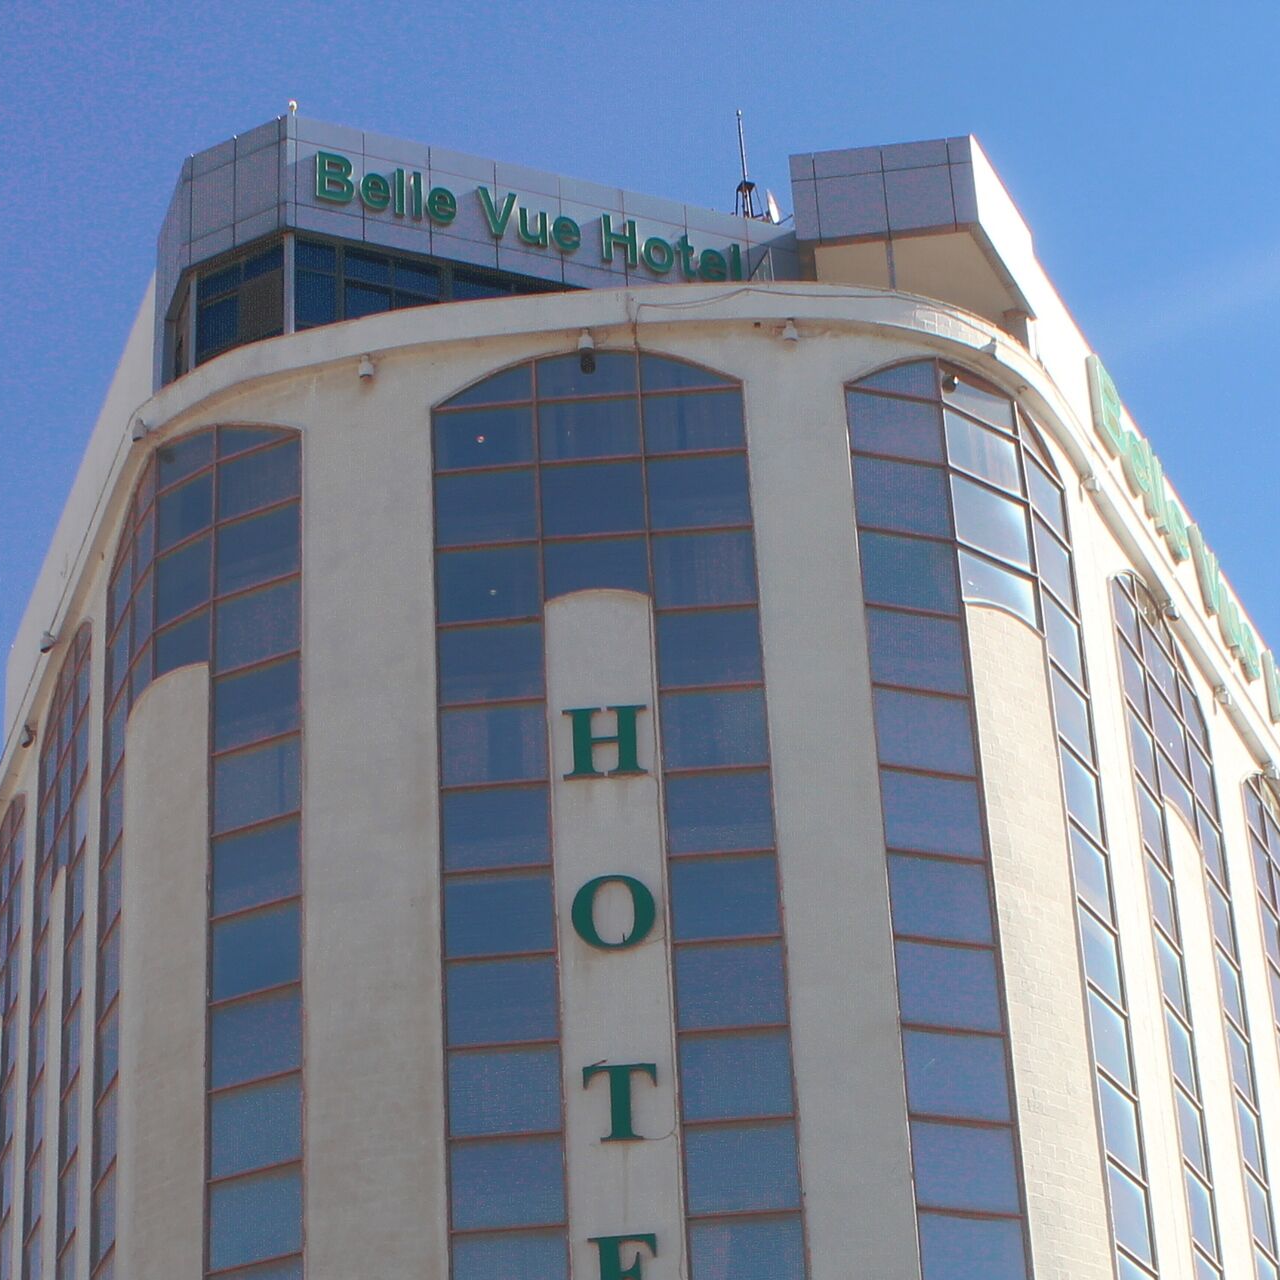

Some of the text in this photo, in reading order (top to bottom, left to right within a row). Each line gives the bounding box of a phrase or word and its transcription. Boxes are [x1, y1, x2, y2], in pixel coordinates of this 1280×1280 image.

[315, 150, 742, 283] Belle Vue Hotel
[1086, 353, 1189, 562] Belle
